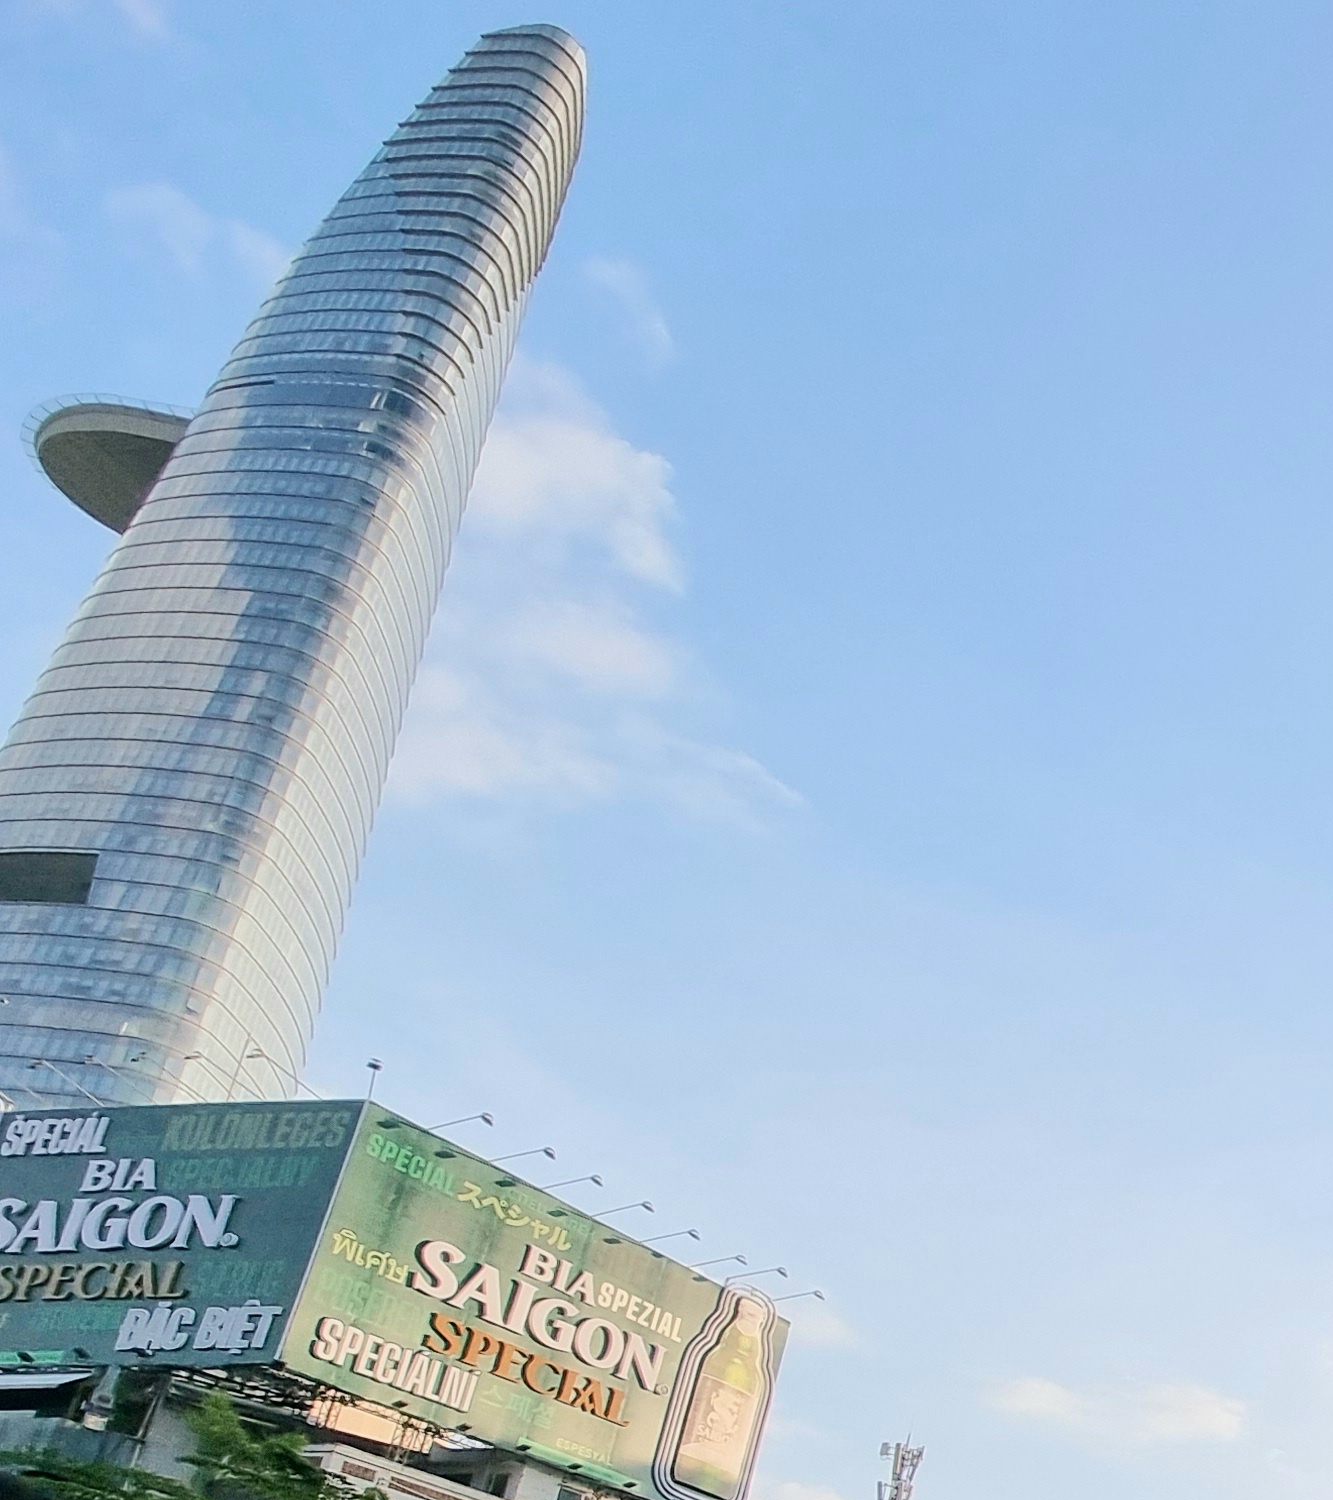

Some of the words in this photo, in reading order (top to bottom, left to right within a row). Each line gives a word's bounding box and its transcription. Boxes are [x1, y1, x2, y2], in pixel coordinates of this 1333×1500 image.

[79, 1158, 157, 1192] BIA
[0, 1194, 241, 1253] SAIGON
[457, 1180, 571, 1250] スペシャル
[0, 1261, 188, 1301] SPECIAL
[332, 1227, 409, 1284] พิเศษ
[520, 1244, 596, 1307] BIA
[193, 1299, 283, 1355] BIỆT
[408, 1239, 668, 1394] SAIGON
[598, 1282, 683, 1343] SPEZIAL
[309, 1317, 482, 1412] SPECIÁLNÍ
[421, 1312, 630, 1427] SPECIAL
[556, 1437, 612, 1467] ESPESYAL
